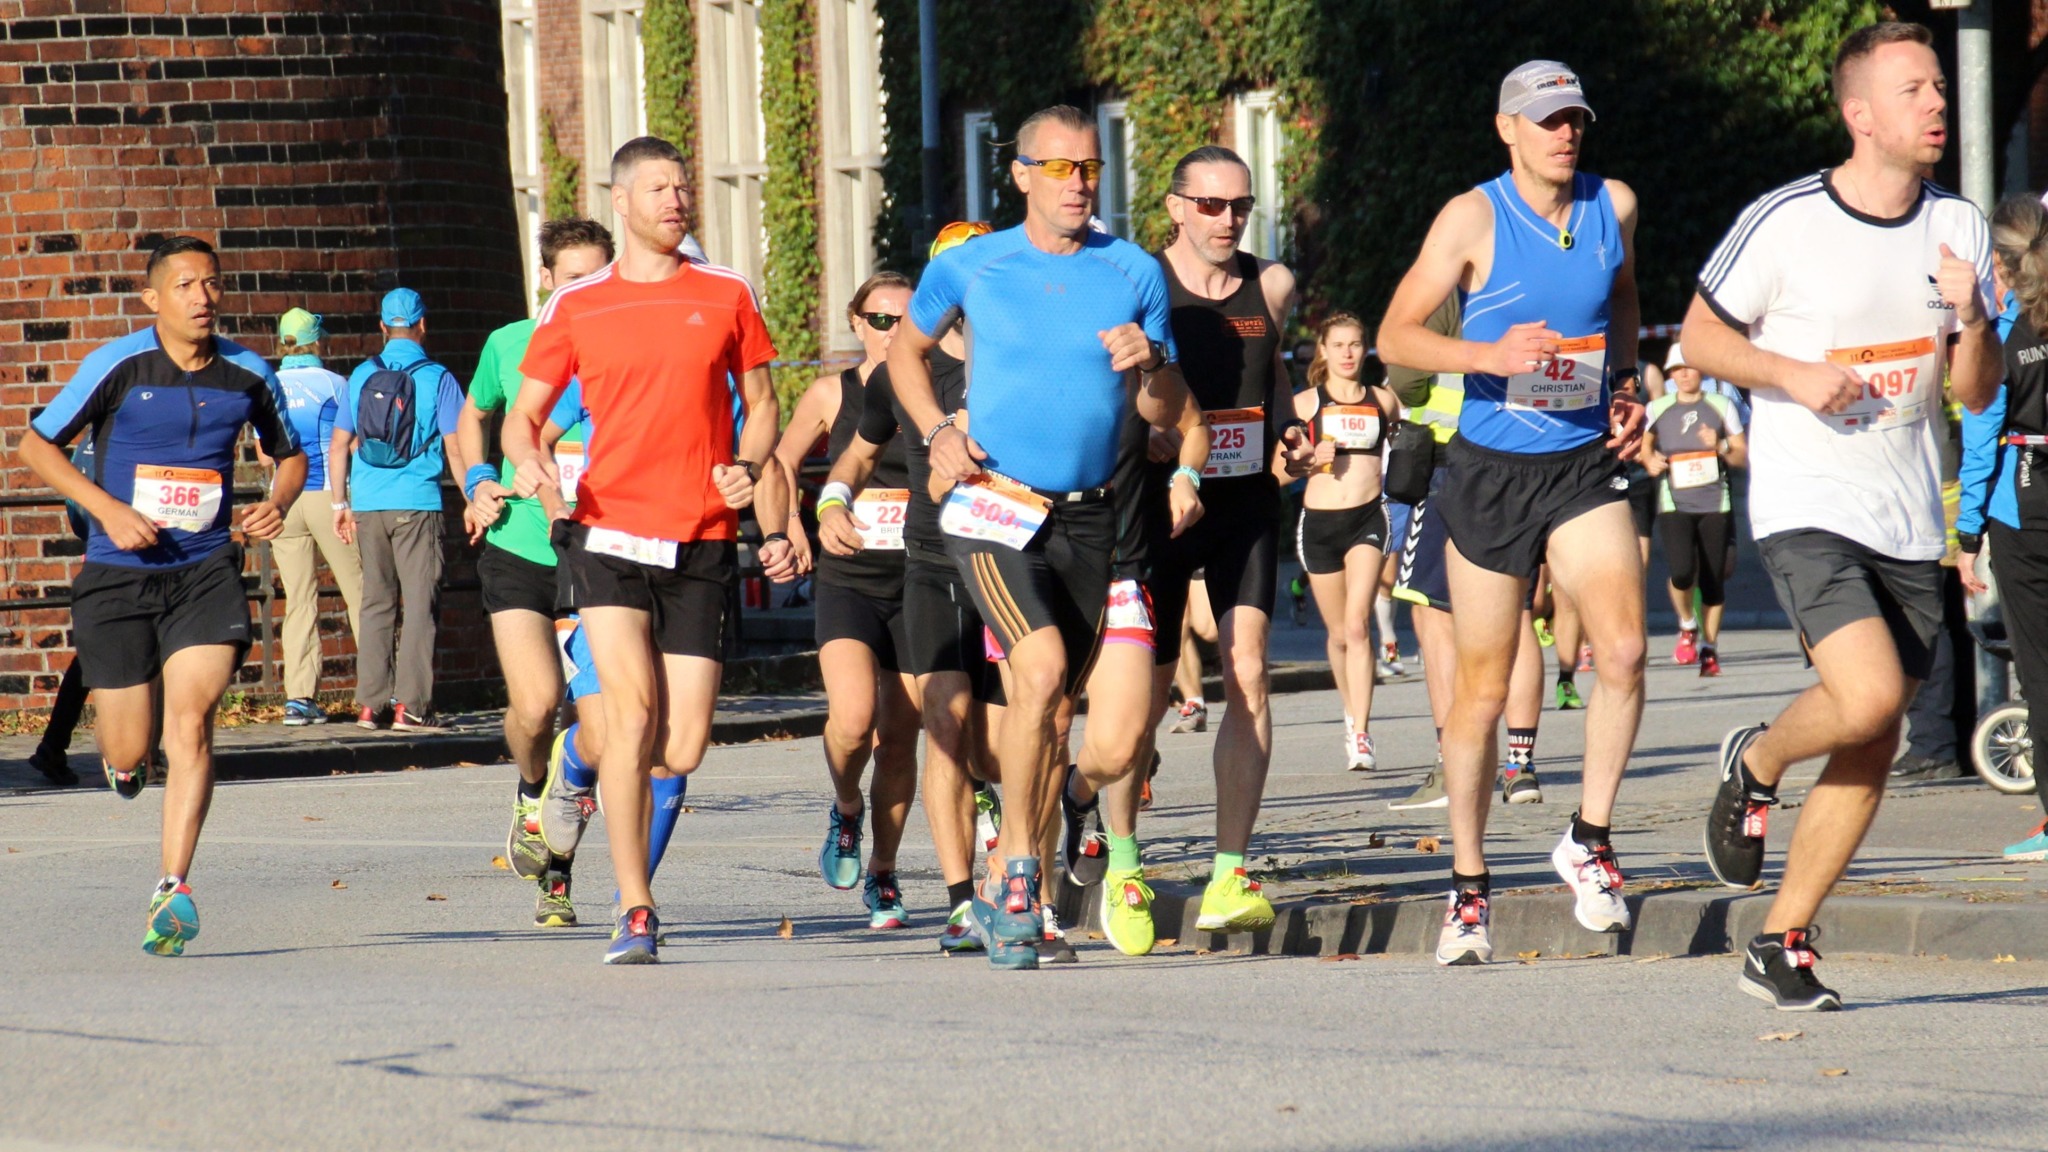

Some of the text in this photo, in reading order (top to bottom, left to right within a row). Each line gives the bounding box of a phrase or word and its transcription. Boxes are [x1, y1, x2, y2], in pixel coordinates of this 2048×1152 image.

[1544, 358, 1576, 381] 42
[1531, 383, 1586, 393] CHRISTIAN
[1857, 367, 1918, 401] 097
[1340, 417, 1366, 431] 160
[1211, 451, 1242, 461] FRANK
[159, 485, 201, 507] 366
[970, 496, 1017, 527] 503
